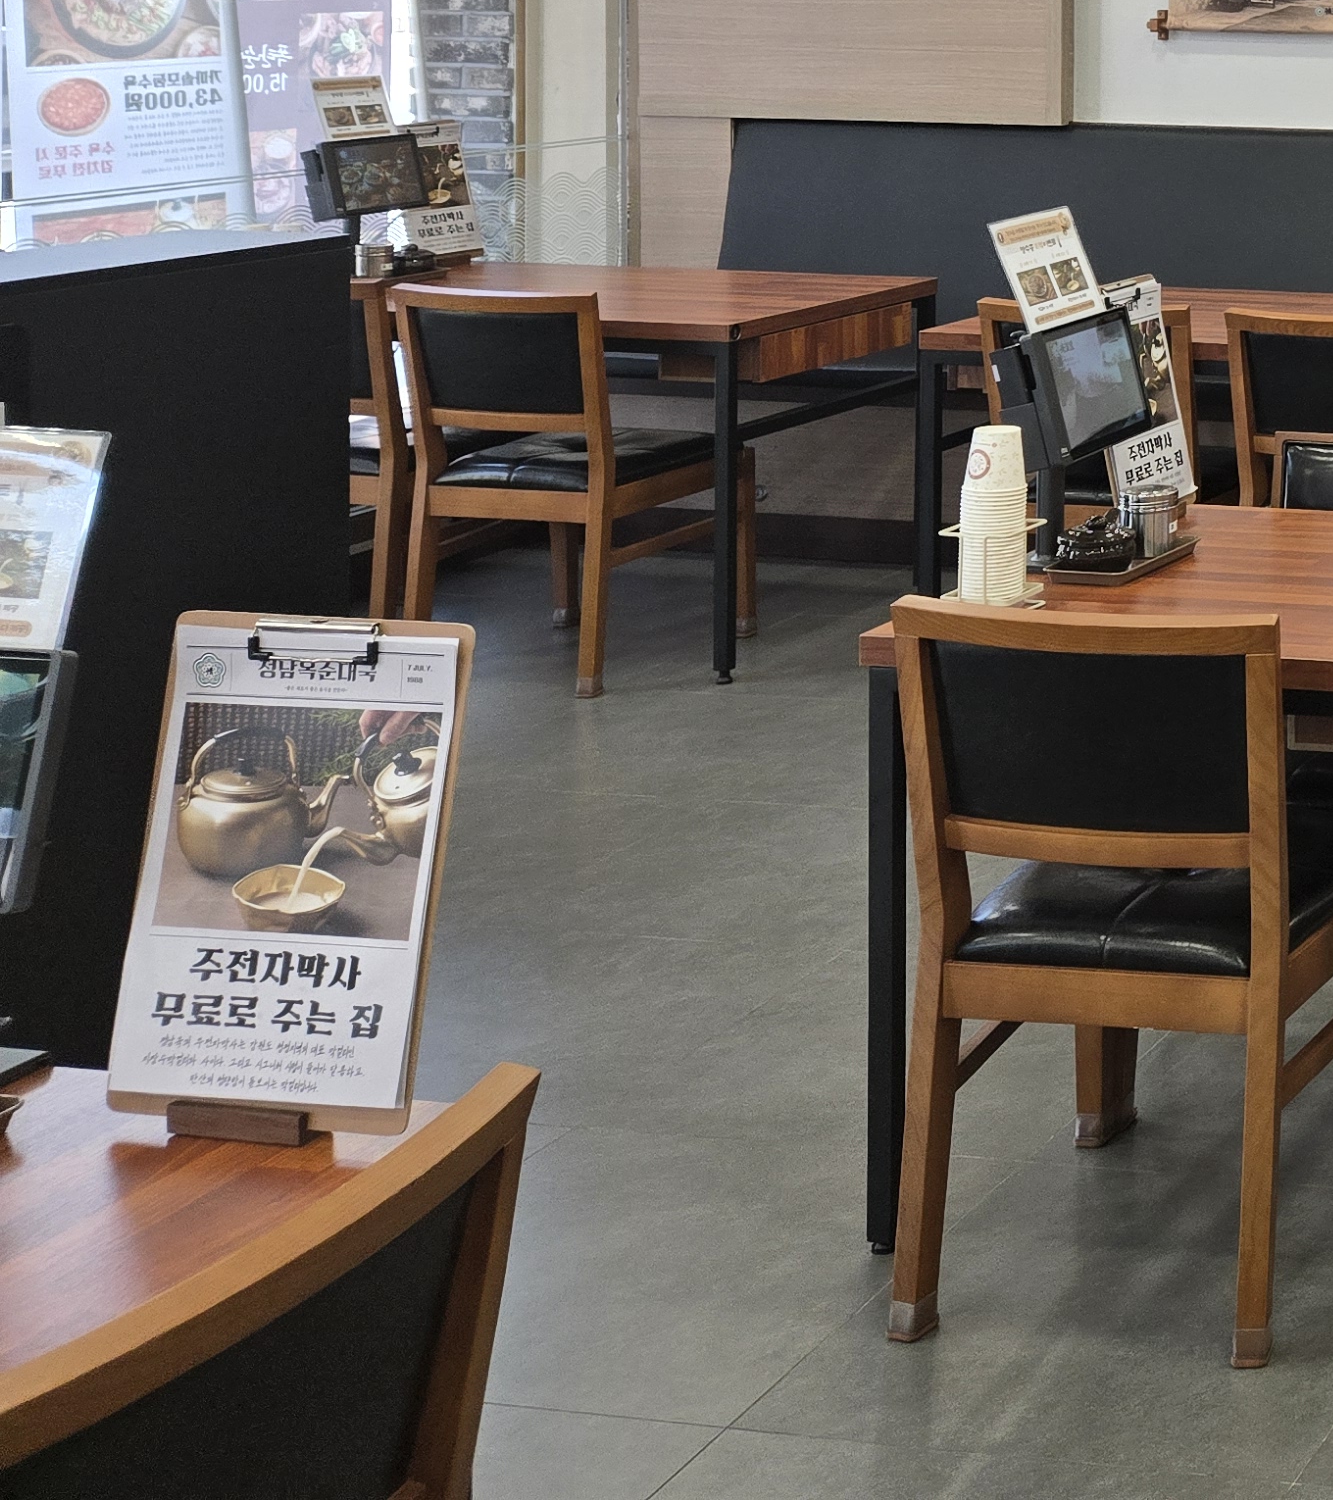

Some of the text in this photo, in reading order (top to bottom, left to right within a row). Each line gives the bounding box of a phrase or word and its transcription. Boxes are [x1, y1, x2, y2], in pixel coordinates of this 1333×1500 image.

[1128, 431, 1174, 461] 주전자막사
[1125, 449, 1185, 486] 무료로 주는 집
[189, 947, 362, 991] 주전자막사
[151, 991, 384, 1039] 무료로 주는 집
